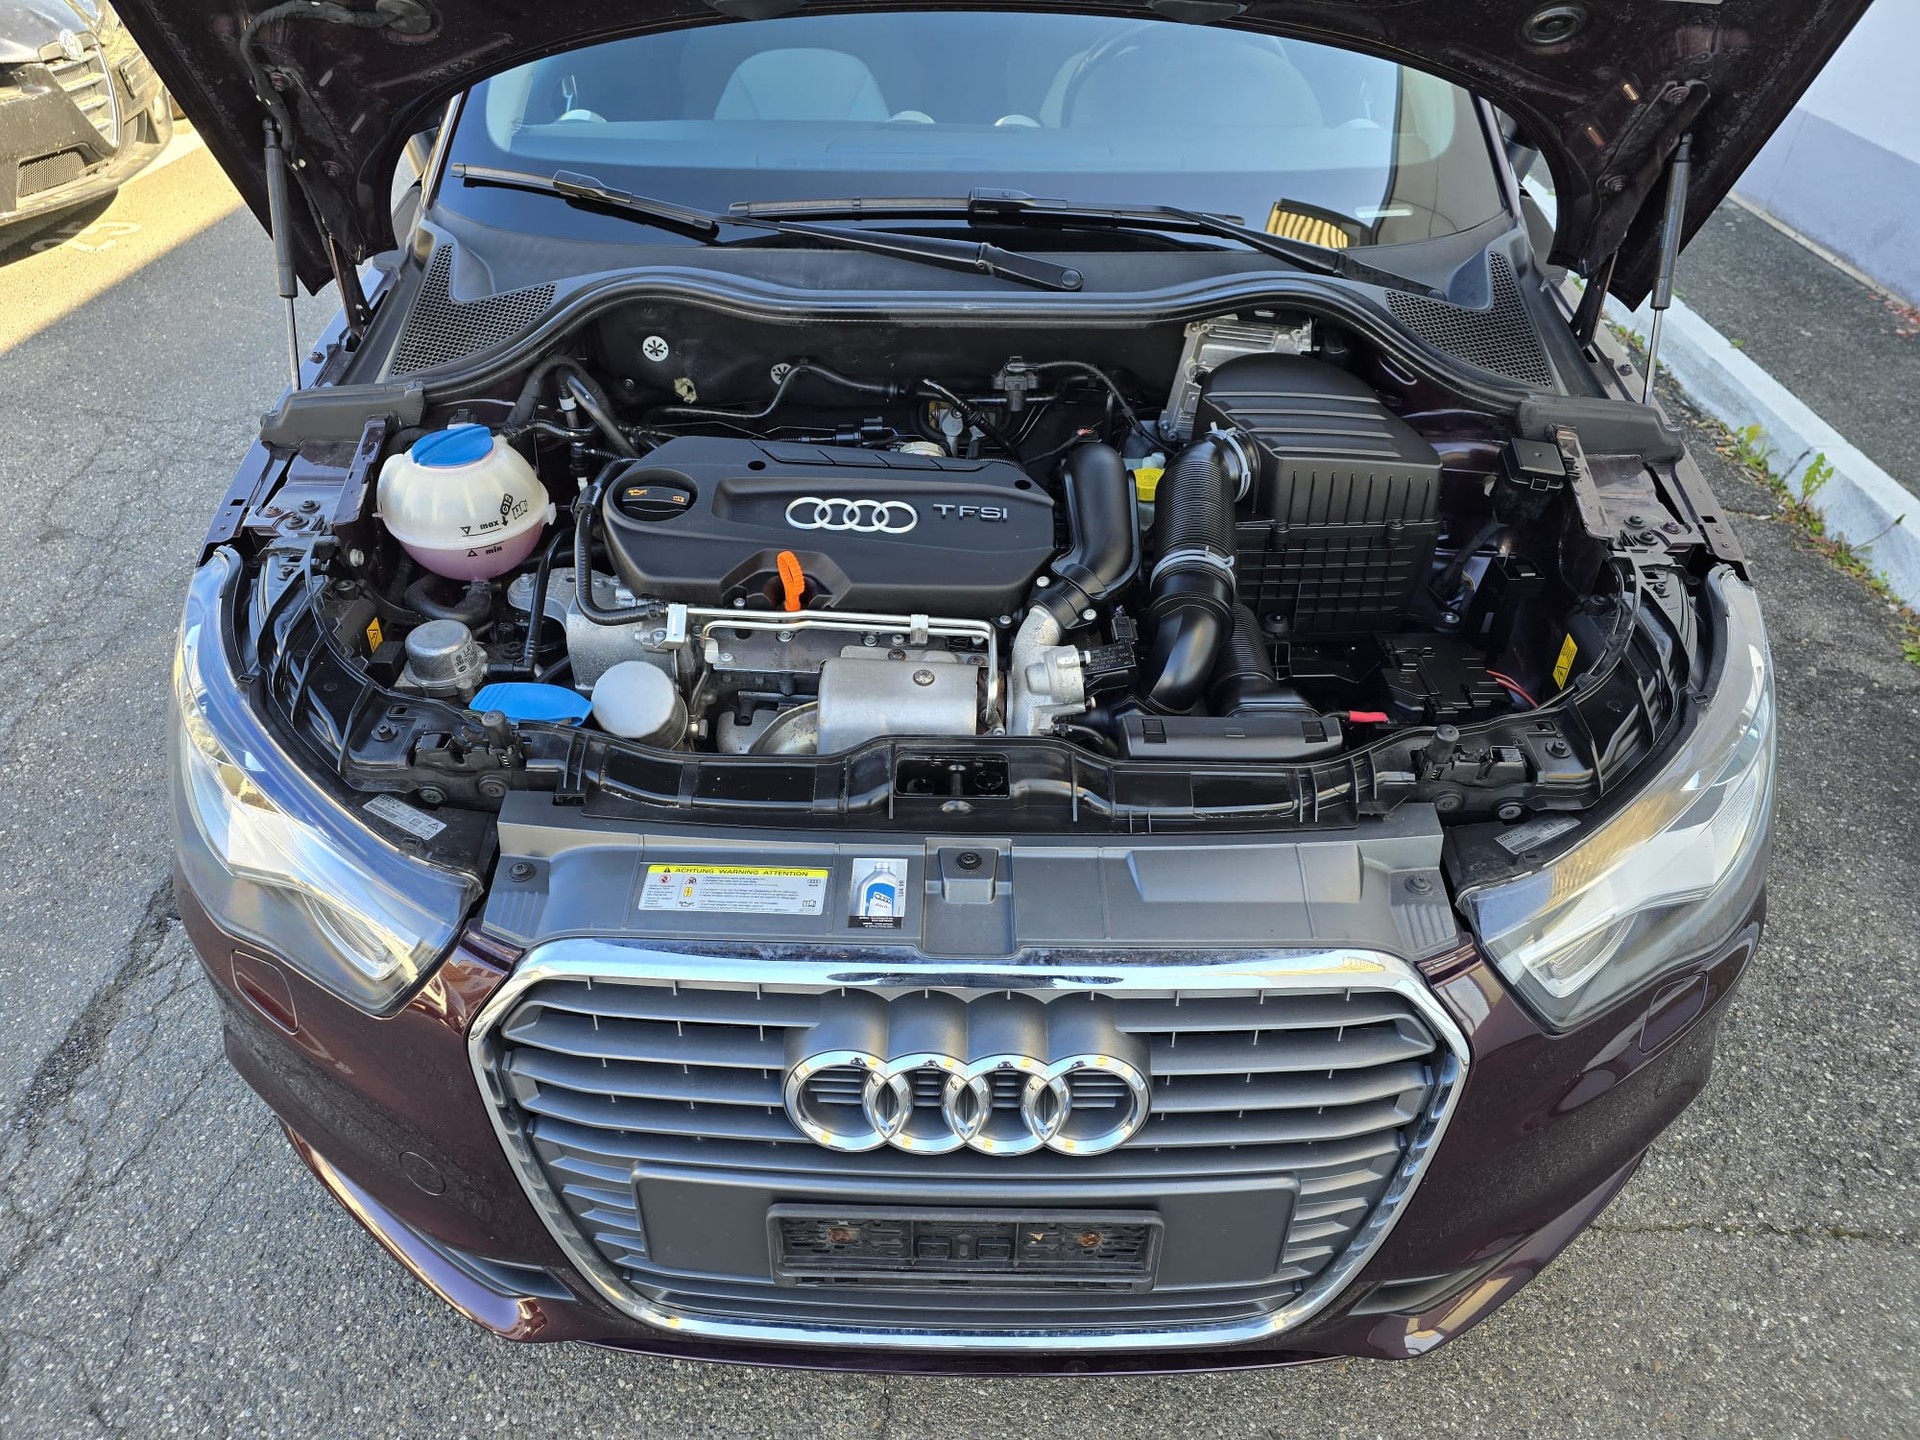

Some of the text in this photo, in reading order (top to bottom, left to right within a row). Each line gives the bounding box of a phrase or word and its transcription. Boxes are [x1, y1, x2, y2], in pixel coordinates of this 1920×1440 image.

[933, 503, 1008, 521] TFSI
[480, 520, 500, 530] max
[486, 546, 502, 555] min
